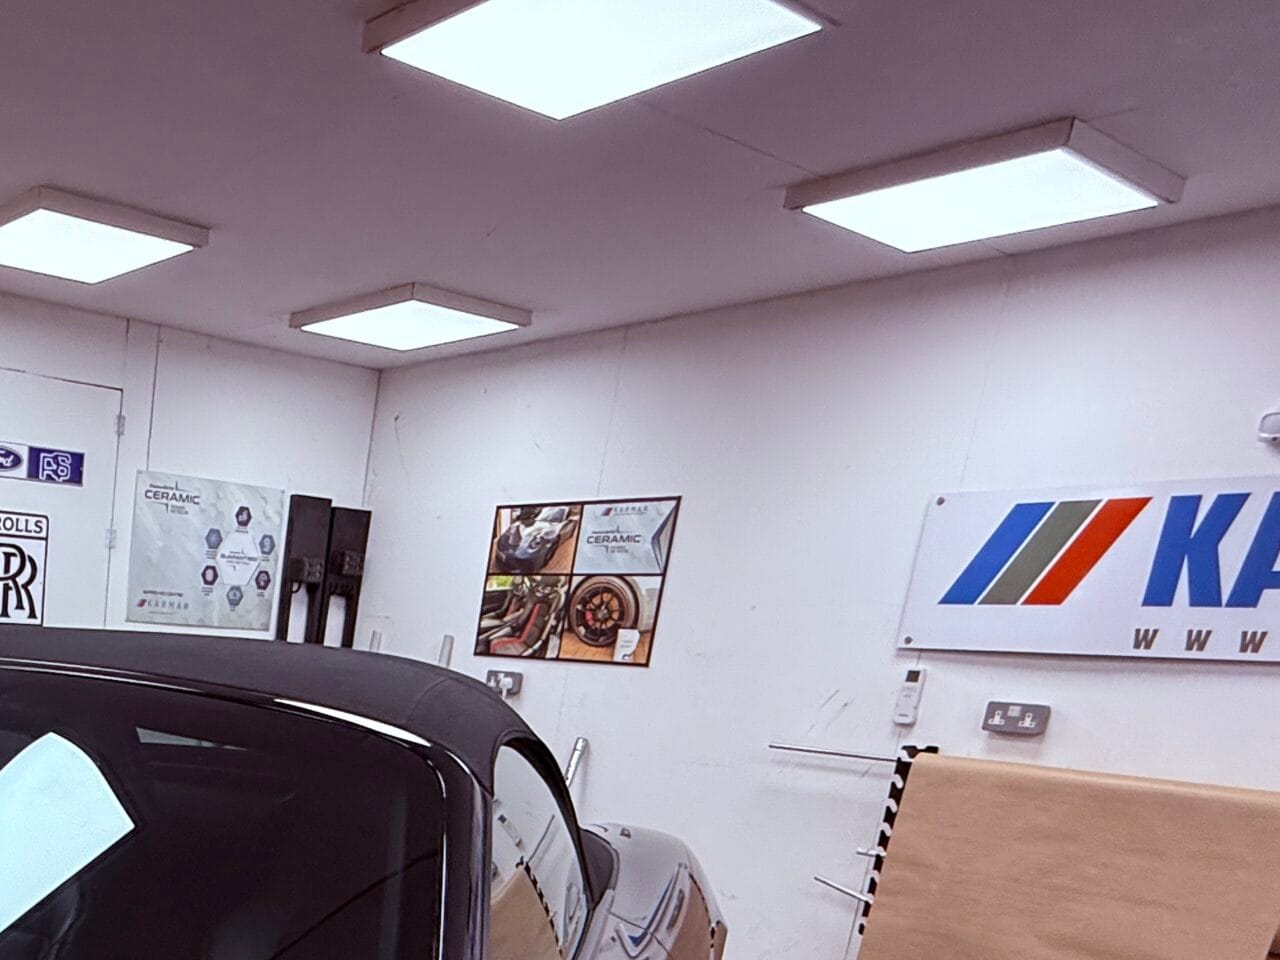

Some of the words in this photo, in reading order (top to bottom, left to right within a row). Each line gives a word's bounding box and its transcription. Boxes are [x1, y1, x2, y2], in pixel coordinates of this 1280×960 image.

[39, 452, 71, 481] RS
[144, 489, 200, 505] CERAMIC
[586, 534, 642, 545] CERAMIC
